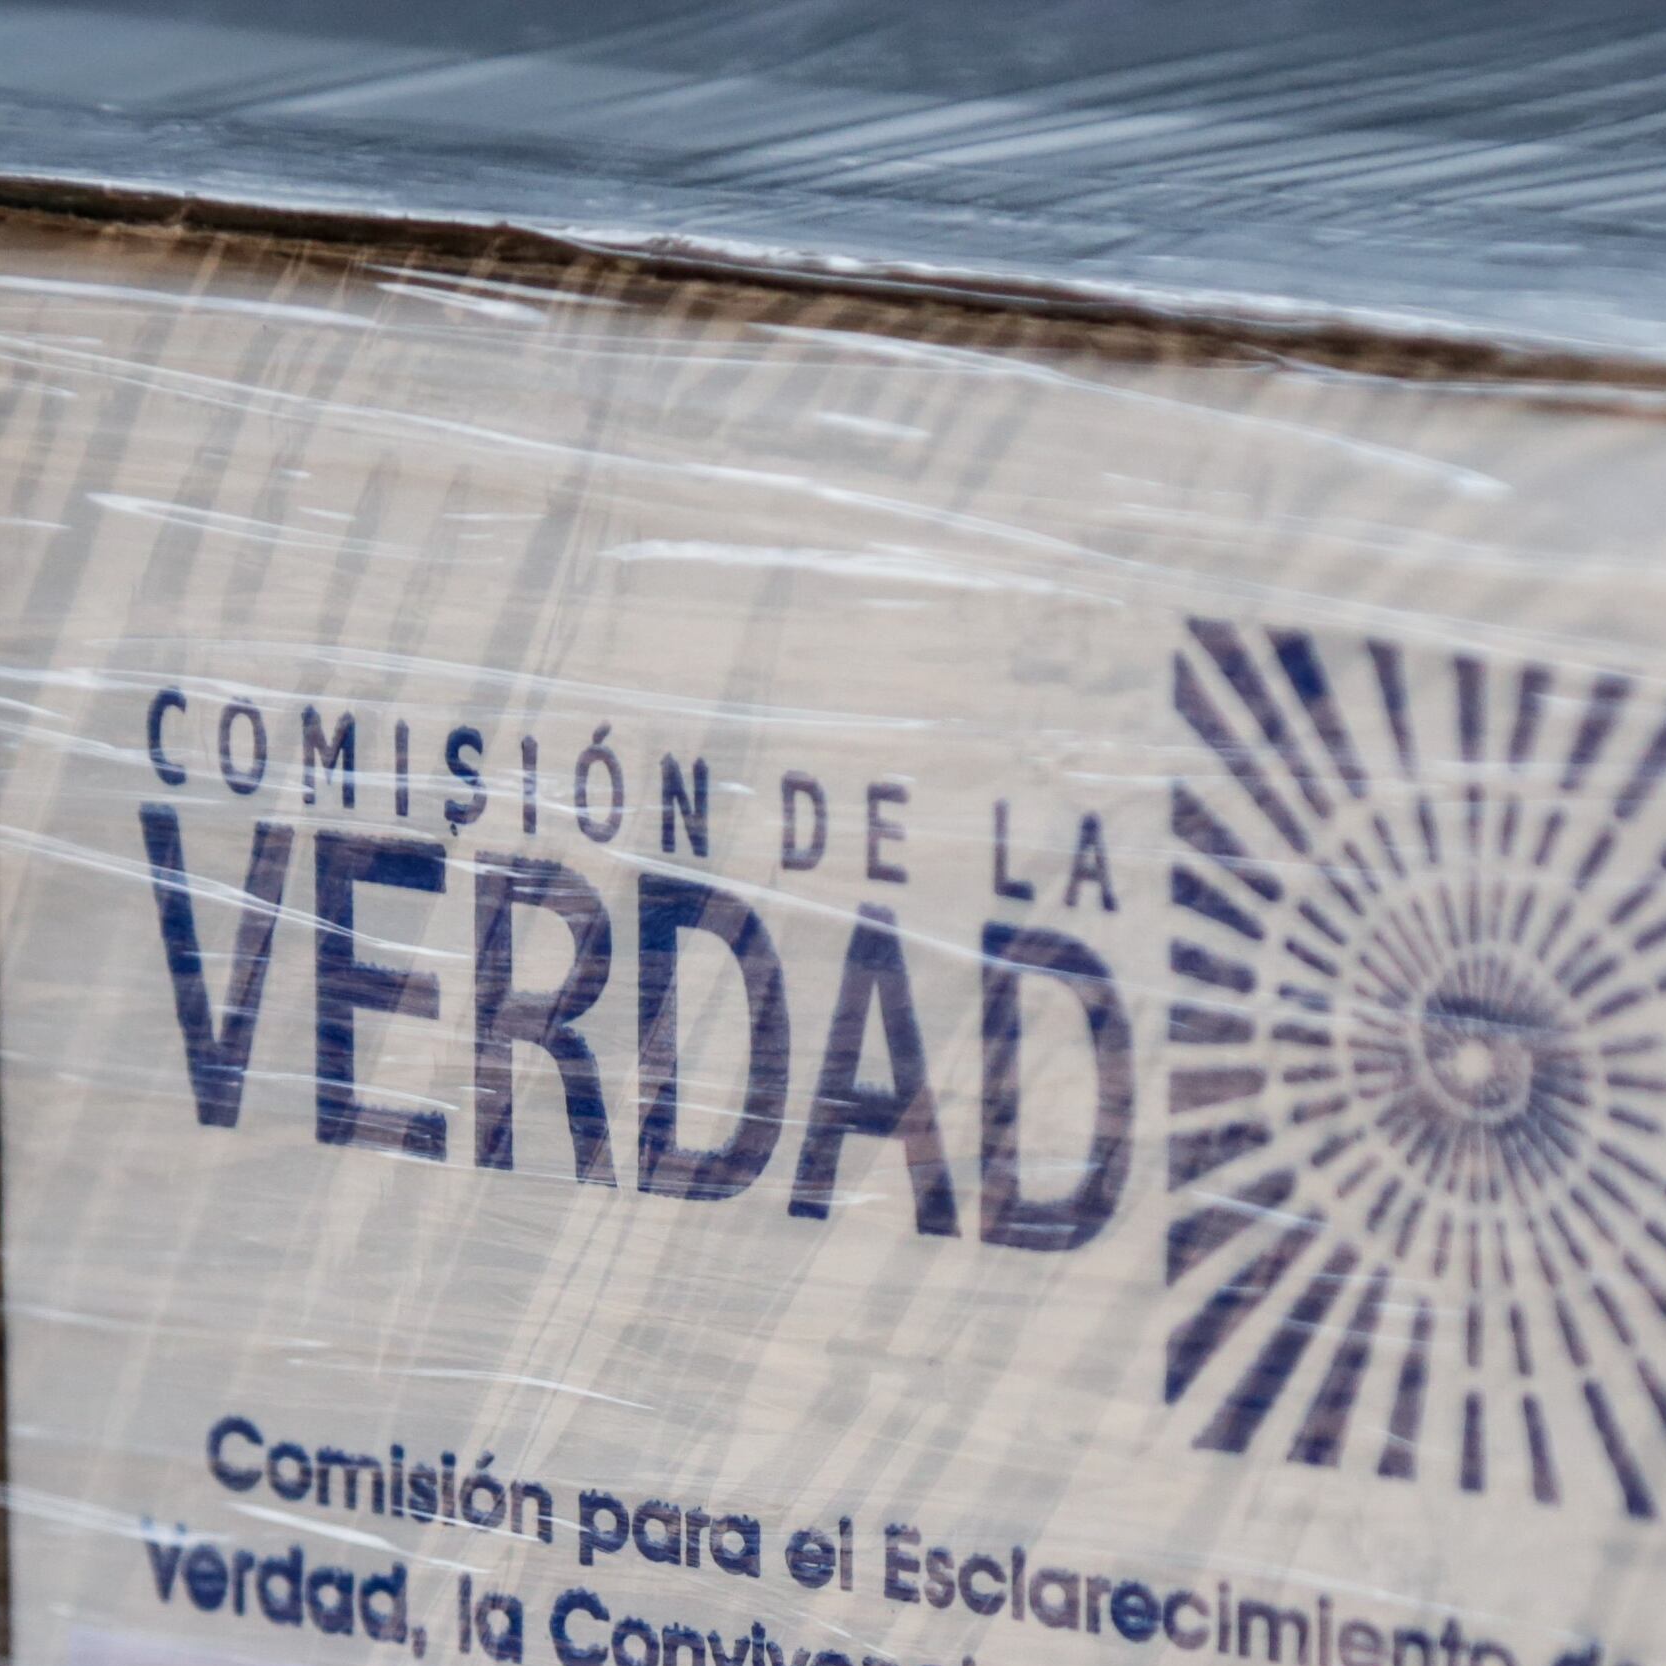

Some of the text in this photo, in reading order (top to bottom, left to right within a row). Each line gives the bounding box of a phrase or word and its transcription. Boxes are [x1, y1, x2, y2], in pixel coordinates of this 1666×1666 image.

[143, 684, 1121, 912] COMISIÓN DE LA
[138, 802, 1136, 1254] VERDAD
[143, 1523, 428, 1664] Verdad,
[457, 1573, 526, 1666] la
[206, 1412, 555, 1548] Comisión
[577, 1487, 761, 1583] para
[785, 1510, 855, 1594] el
